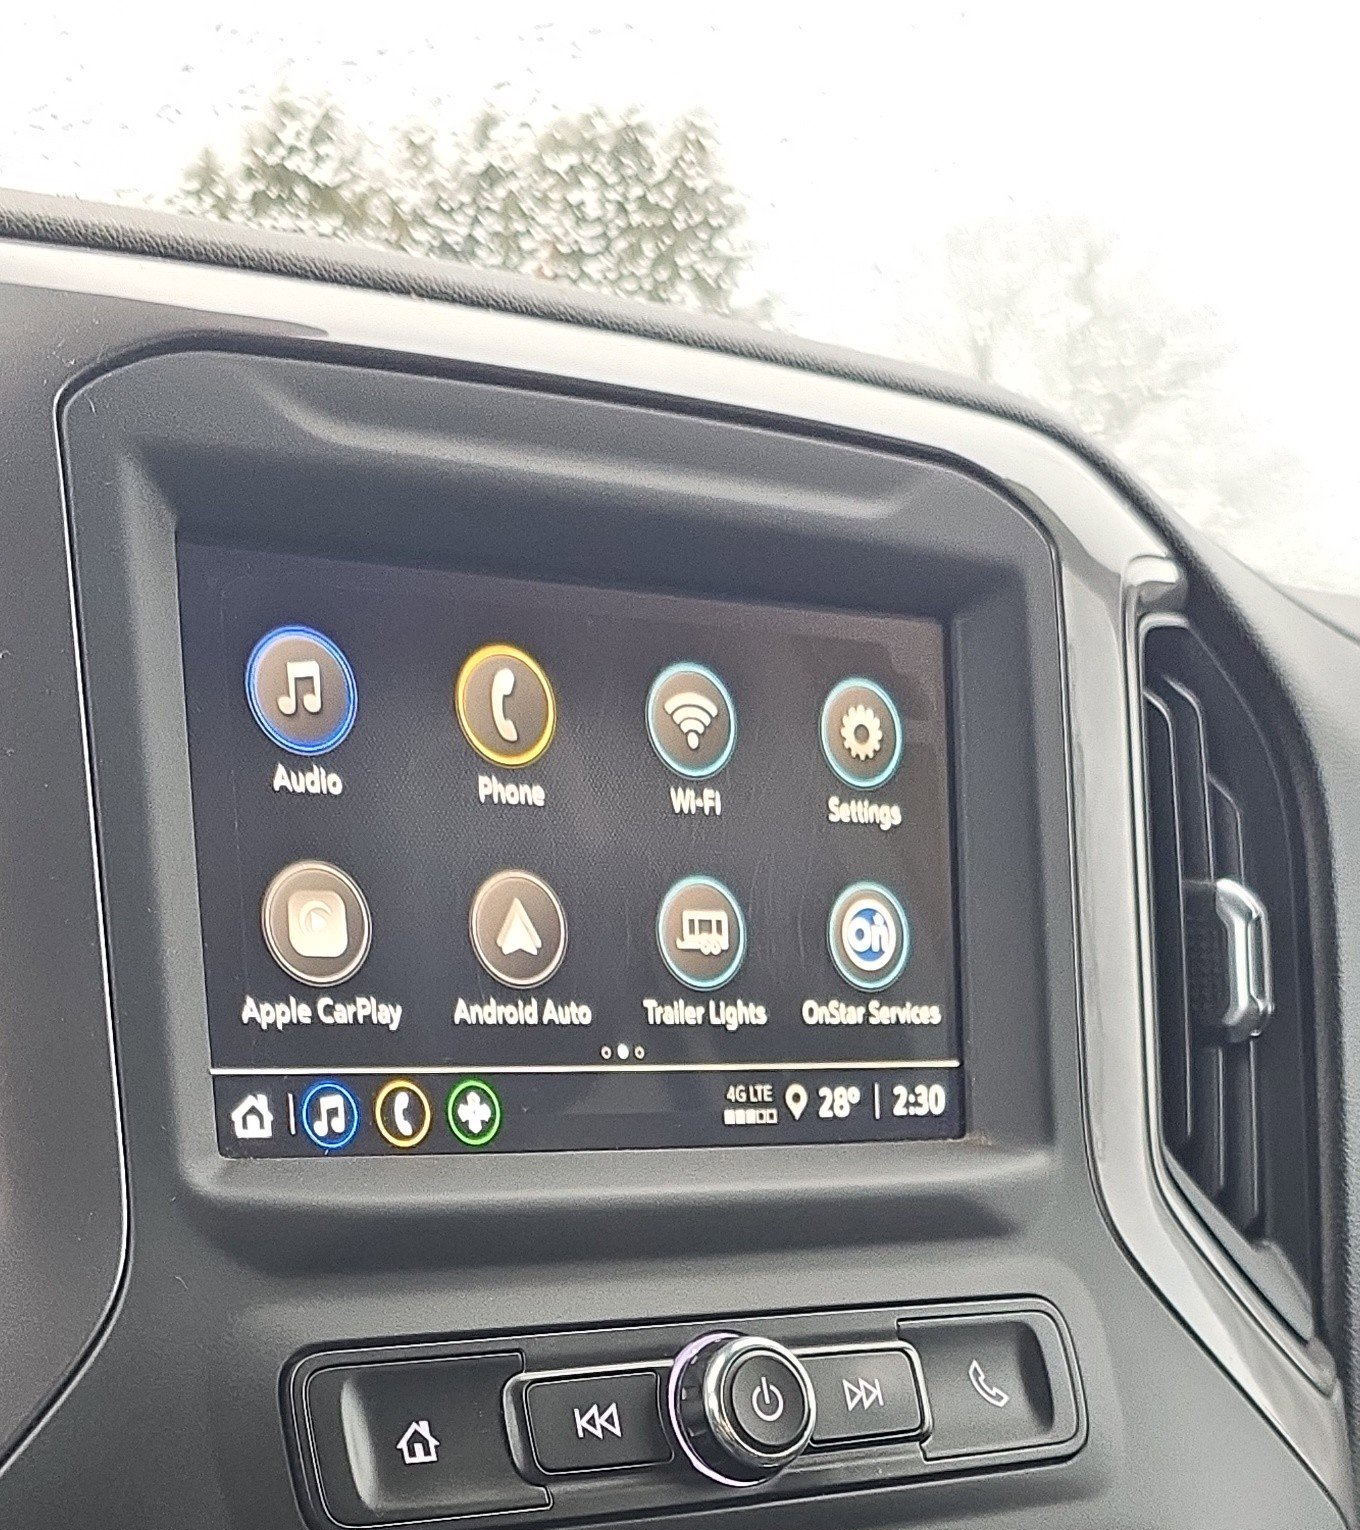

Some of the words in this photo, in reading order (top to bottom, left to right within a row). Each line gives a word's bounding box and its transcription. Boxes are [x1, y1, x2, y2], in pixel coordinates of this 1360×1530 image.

[273, 763, 343, 795] Audio
[477, 775, 545, 807] Phone
[670, 787, 722, 816] Wi-Fi
[827, 796, 902, 830] Settings
[242, 995, 312, 1031] Apple
[317, 996, 402, 1031] CarPlay
[454, 997, 539, 1026] Android
[542, 998, 592, 1026] Auto
[643, 999, 705, 1026] Trailer
[709, 999, 768, 1031] Lights
[802, 1000, 866, 1026] OnStar
[868, 1000, 942, 1026] Services
[726, 1085, 747, 1103] 4G
[749, 1084, 773, 1102] LTE
[893, 1083, 946, 1117] 2:30
